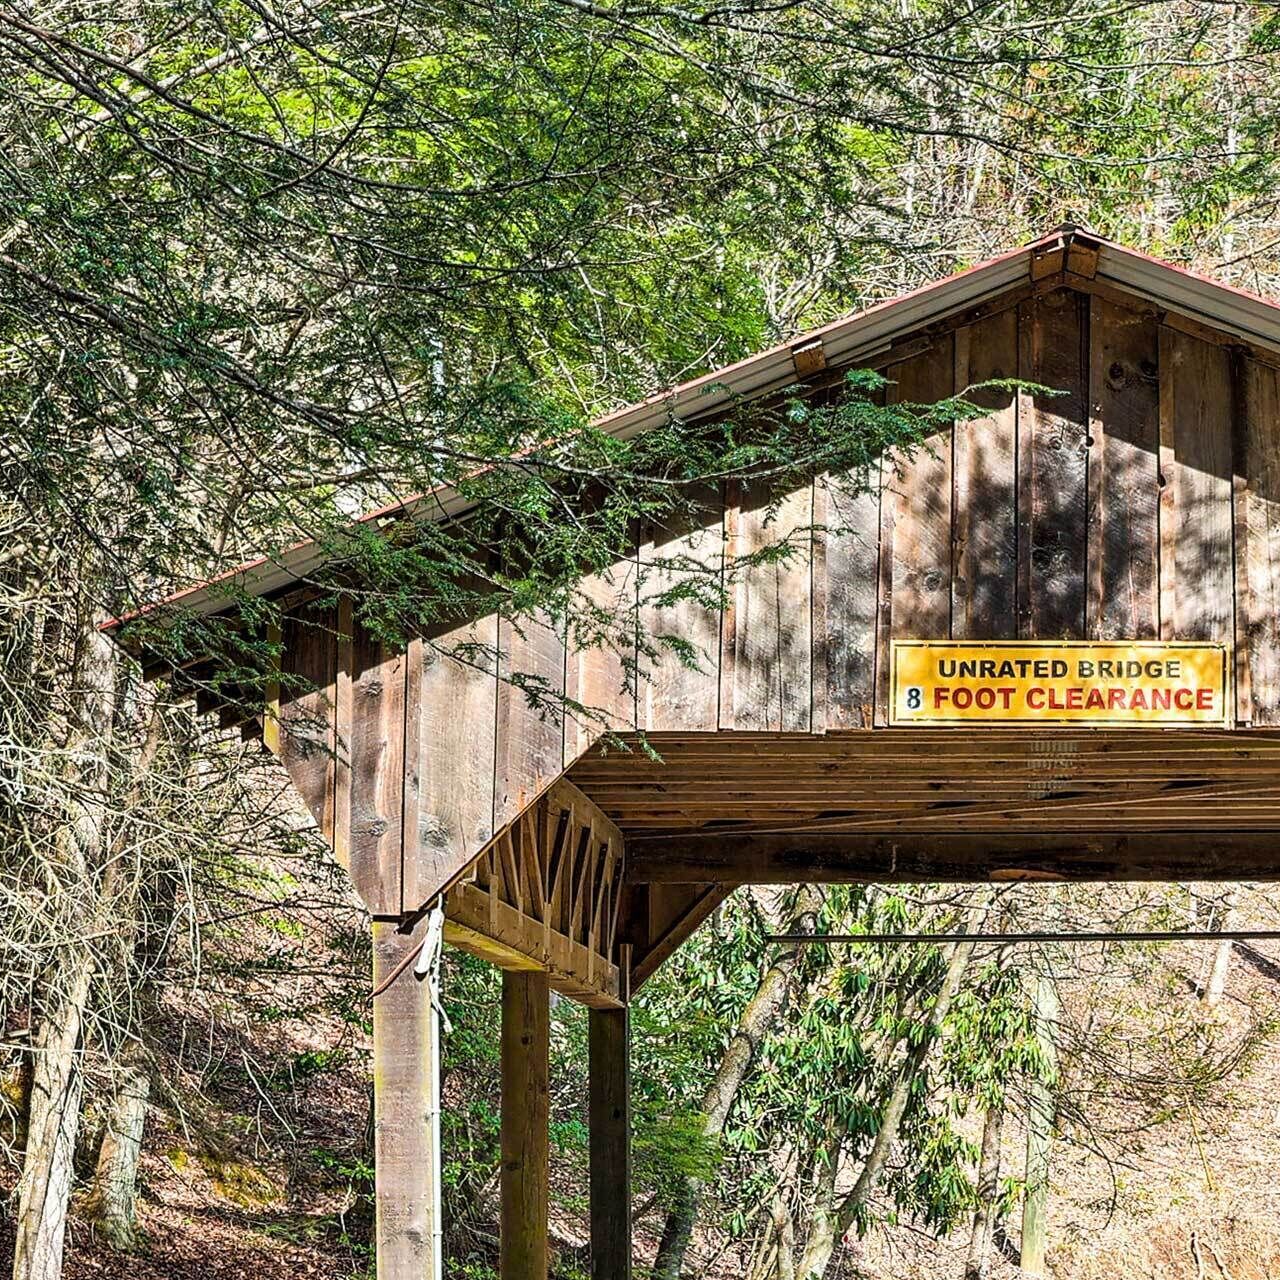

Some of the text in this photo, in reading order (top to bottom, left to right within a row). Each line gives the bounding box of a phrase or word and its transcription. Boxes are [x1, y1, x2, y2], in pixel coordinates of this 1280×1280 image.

[938, 659, 1181, 679] UNRATED BRIDGE
[906, 687, 1214, 711] 8 FOOT CLEARANCE
